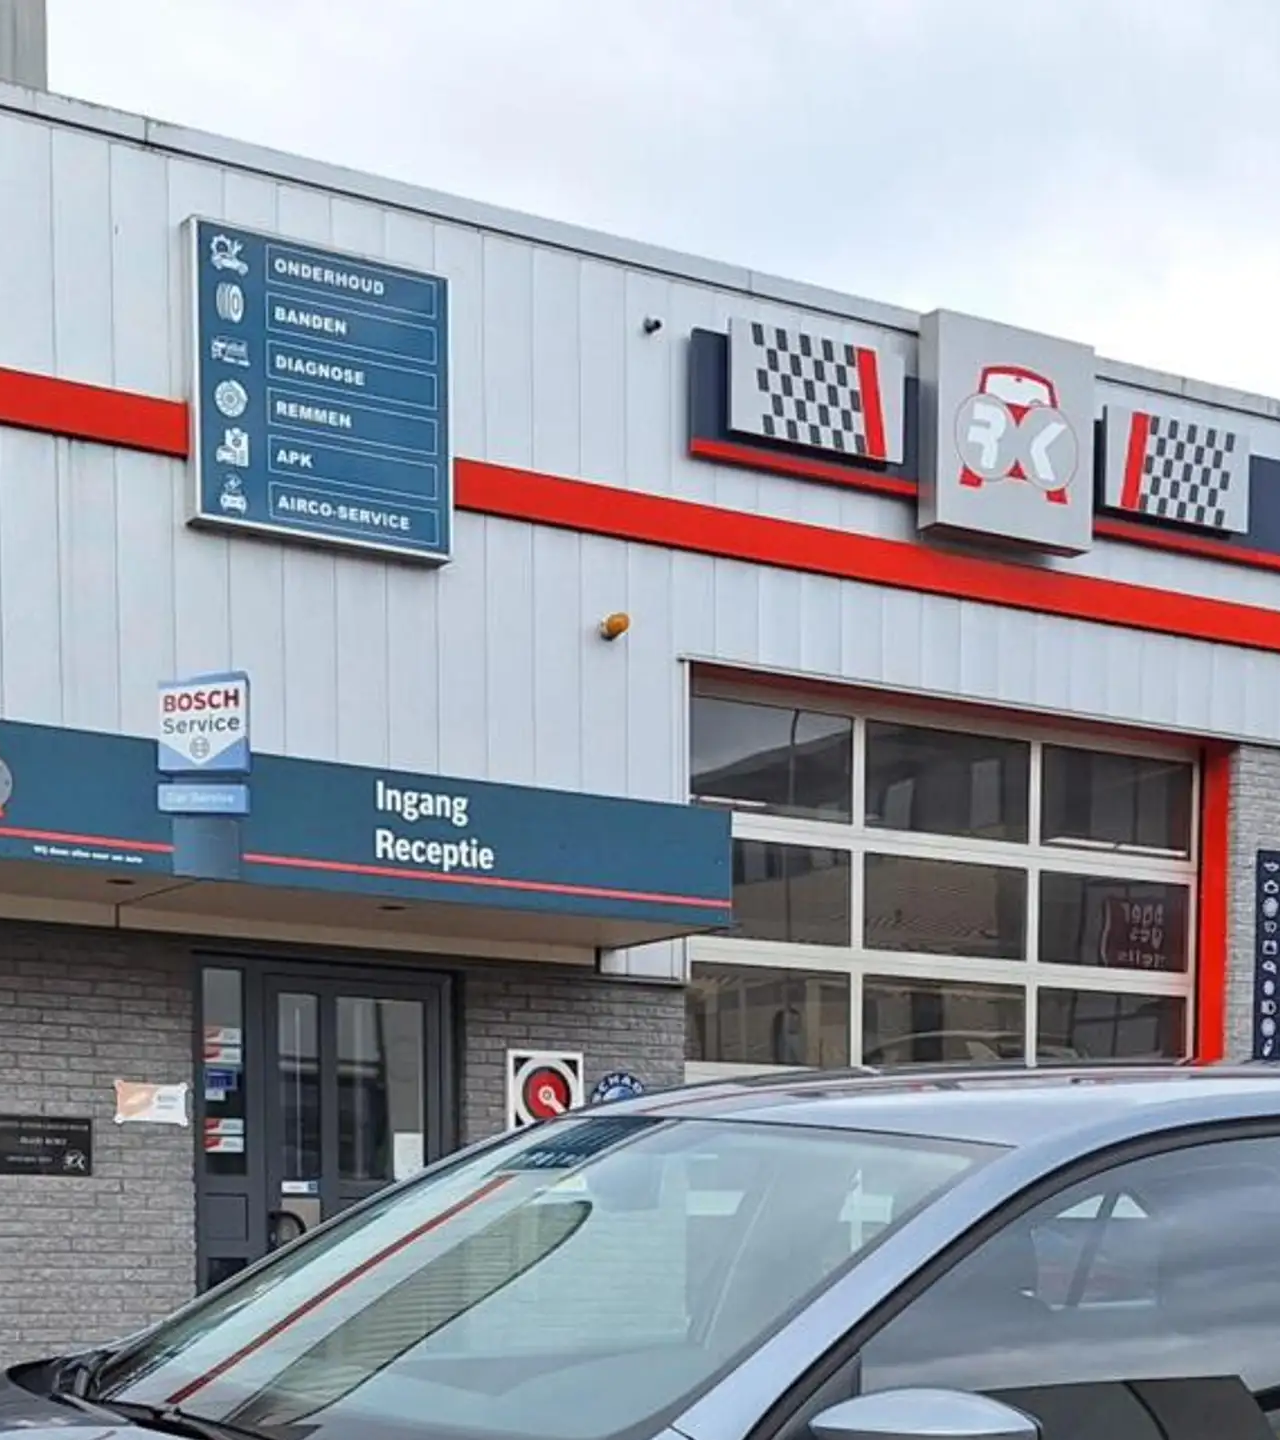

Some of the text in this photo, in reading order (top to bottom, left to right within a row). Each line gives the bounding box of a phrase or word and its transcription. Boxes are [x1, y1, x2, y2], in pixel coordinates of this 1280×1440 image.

[274, 257, 384, 295] ONDERHOUD
[274, 307, 347, 334] BANDEN
[276, 355, 365, 386] DIAGNOSE
[276, 400, 352, 428] REMMEN
[276, 449, 313, 468] APK
[277, 495, 411, 530] AIRCO-SERVICE
[163, 688, 239, 712] BOSCH
[163, 714, 240, 734] Service
[376, 780, 469, 827] Ingang
[376, 829, 495, 872] Receptie
